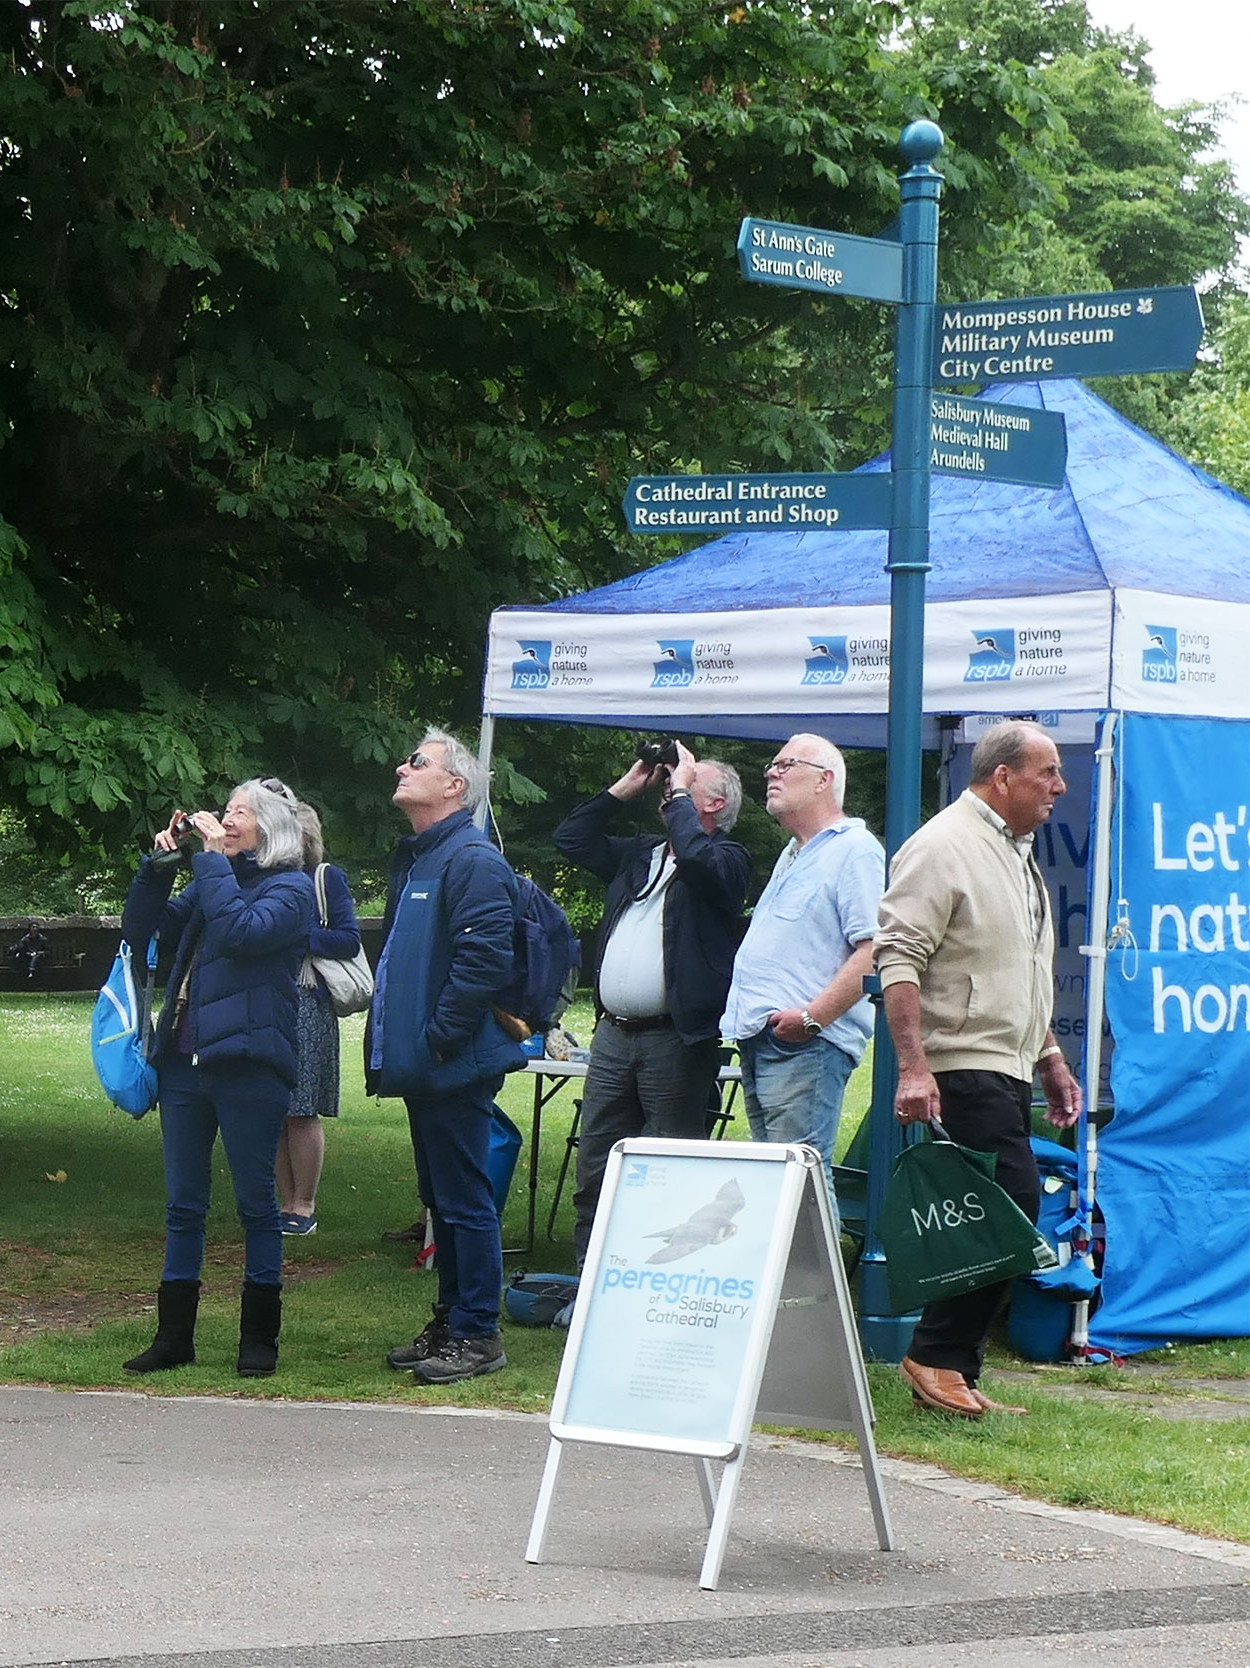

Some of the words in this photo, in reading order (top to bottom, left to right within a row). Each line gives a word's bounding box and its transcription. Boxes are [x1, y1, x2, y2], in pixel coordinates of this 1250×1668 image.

[752, 227, 766, 248] St
[769, 230, 803, 253] Ann's
[804, 236, 835, 258] Gate
[751, 252, 793, 277] Sarum
[795, 259, 843, 287] College
[941, 305, 1062, 331] Mompesson
[1067, 302, 1132, 322] House
[941, 333, 1022, 354] Military
[1026, 328, 1114, 348] Museum
[939, 359, 981, 381] City
[983, 354, 1054, 376] Centre
[931, 399, 982, 427] Salisbury
[982, 408, 1030, 432] Museum
[930, 423, 982, 448] Medieval
[984, 431, 1009, 452] Hall
[930, 448, 986, 472] Arundells
[635, 480, 733, 502] Cathedral
[738, 481, 827, 501] Entrance
[634, 506, 741, 526] Restaurant
[746, 504, 784, 524] and
[788, 503, 840, 526] Shop
[849, 637, 888, 652] giving
[1018, 628, 1062, 645] giving
[1179, 630, 1210, 649] giving
[554, 641, 588, 657] giving
[695, 640, 732, 657] giving
[1019, 645, 1063, 660] nature
[1179, 651, 1211, 664] nature
[551, 659, 588, 671] nature
[696, 657, 734, 670] nature
[966, 661, 1011, 682] rspb
[1015, 667, 1024, 677] a
[1025, 662, 1067, 676] home
[1143, 659, 1176, 683] rspb
[513, 668, 549, 689] rspb
[551, 678, 560, 686] a
[561, 675, 594, 686] home
[653, 668, 692, 688] rspb
[694, 677, 702, 685] a
[703, 673, 739, 684] home
[803, 666, 845, 685] rspb
[848, 674, 857, 682] a
[858, 670, 890, 682] hom
[1179, 670, 1186, 681] a
[1187, 667, 1216, 683] home
[1152, 802, 1250, 872] Let'
[1150, 892, 1250, 953] nat
[911, 1192, 986, 1237] M&S
[609, 1254, 628, 1267] The
[601, 1266, 755, 1303] peregrines
[649, 1293, 662, 1304] of
[678, 1296, 750, 1320] Salisbury
[646, 1308, 718, 1329] Cathedral
